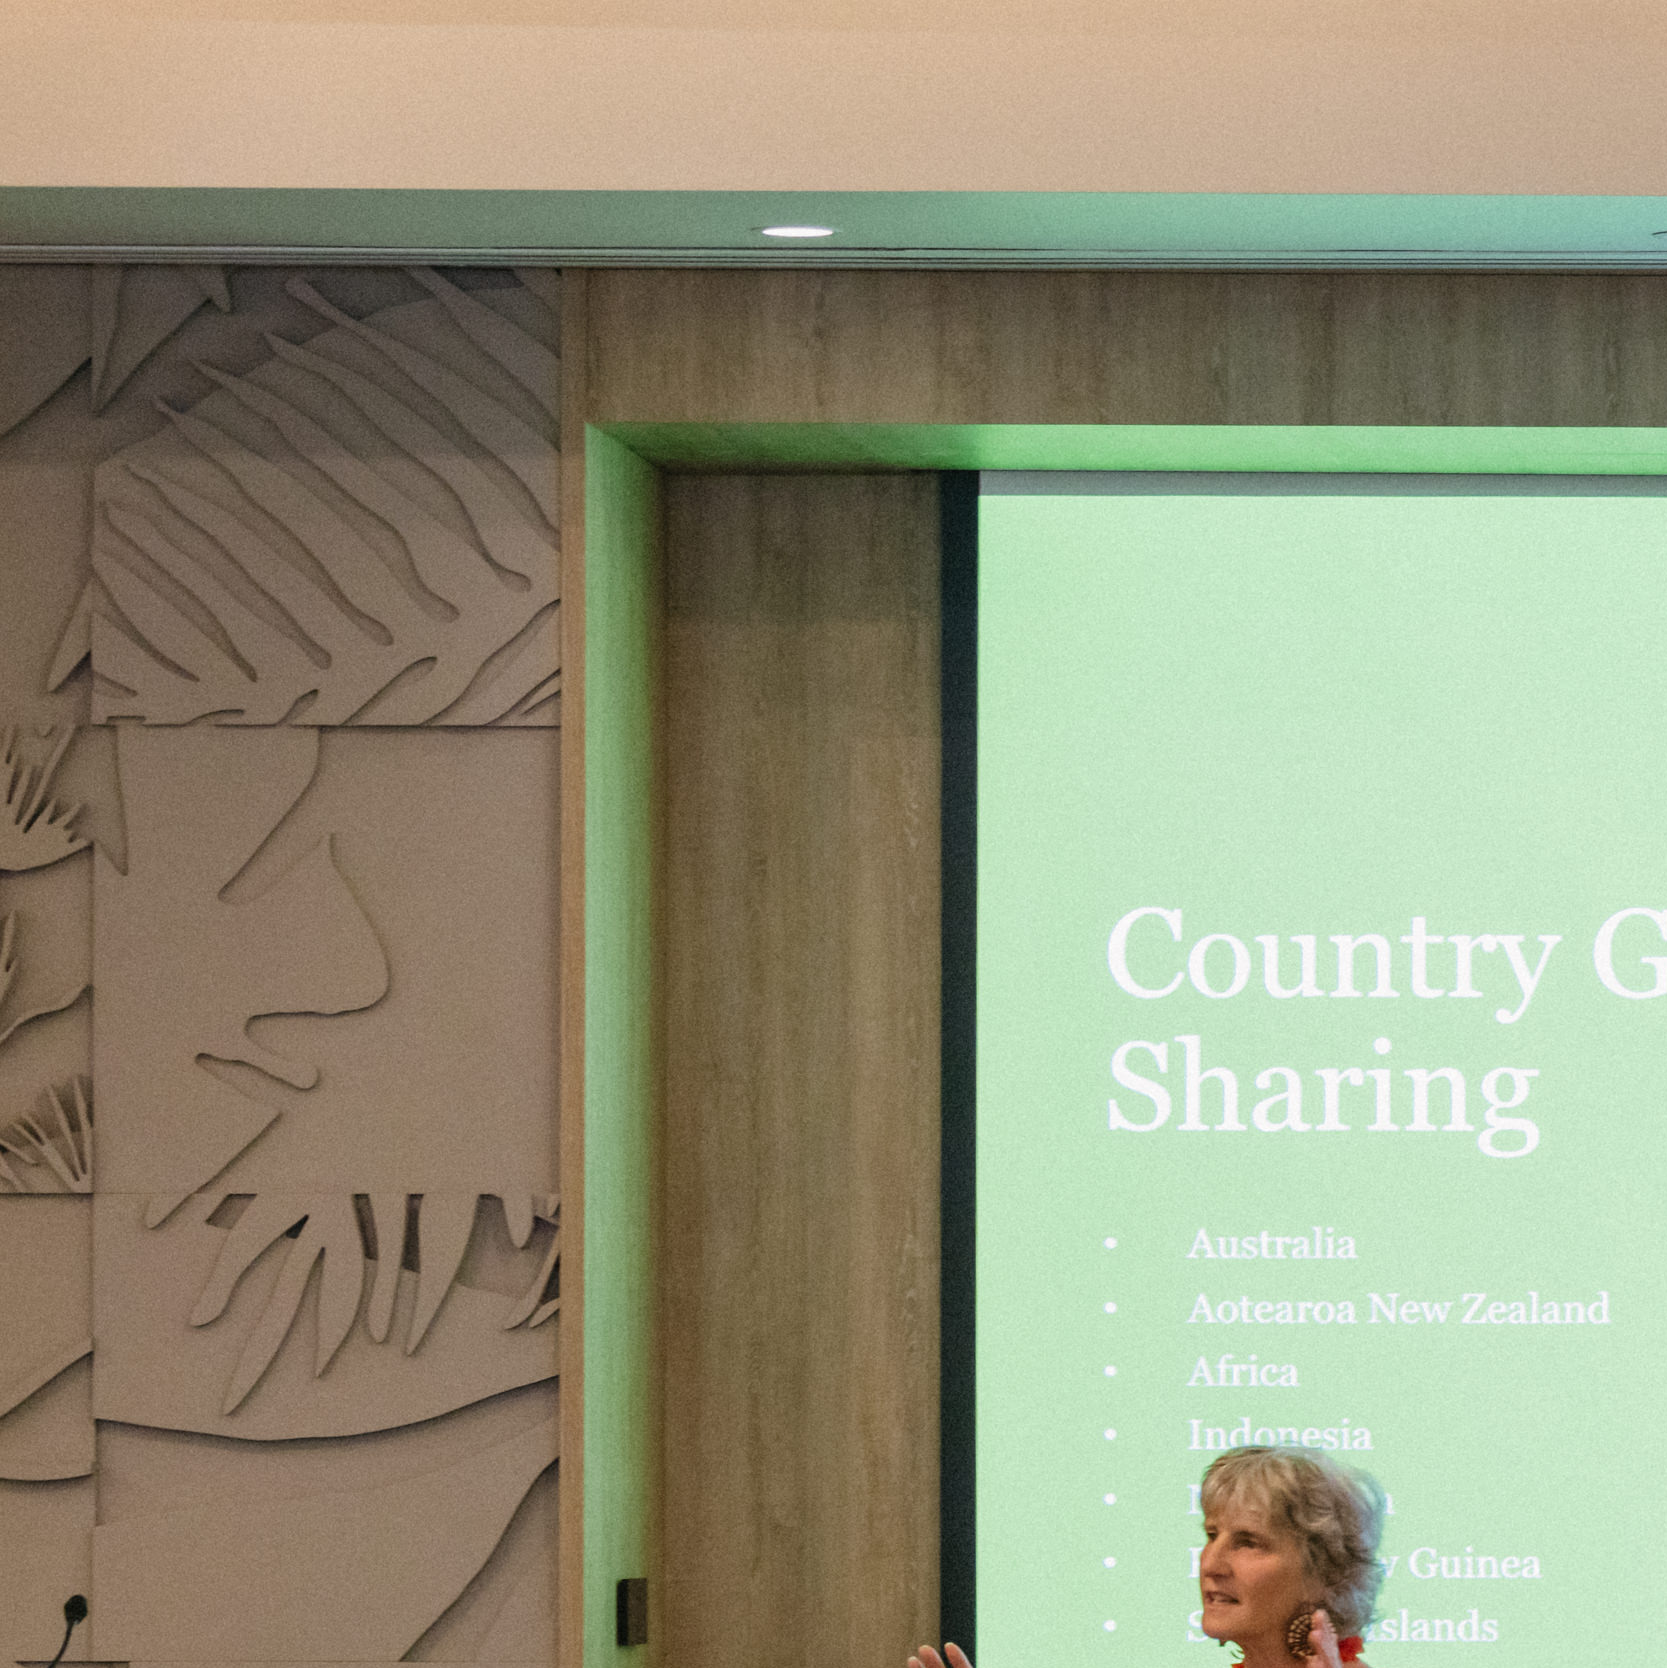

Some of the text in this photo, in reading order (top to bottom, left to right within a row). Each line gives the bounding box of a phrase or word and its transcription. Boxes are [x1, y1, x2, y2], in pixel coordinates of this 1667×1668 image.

[1106, 906, 1562, 1024] Country
[1106, 1035, 1541, 1159] Sharing
[1185, 1226, 1358, 1260] Australia
[1186, 1290, 1611, 1325] Aotearoa New Zealand
[1186, 1354, 1301, 1387] Africa
[1187, 1416, 1374, 1451] Indonesia
[1407, 1545, 1543, 1579] Guinea
